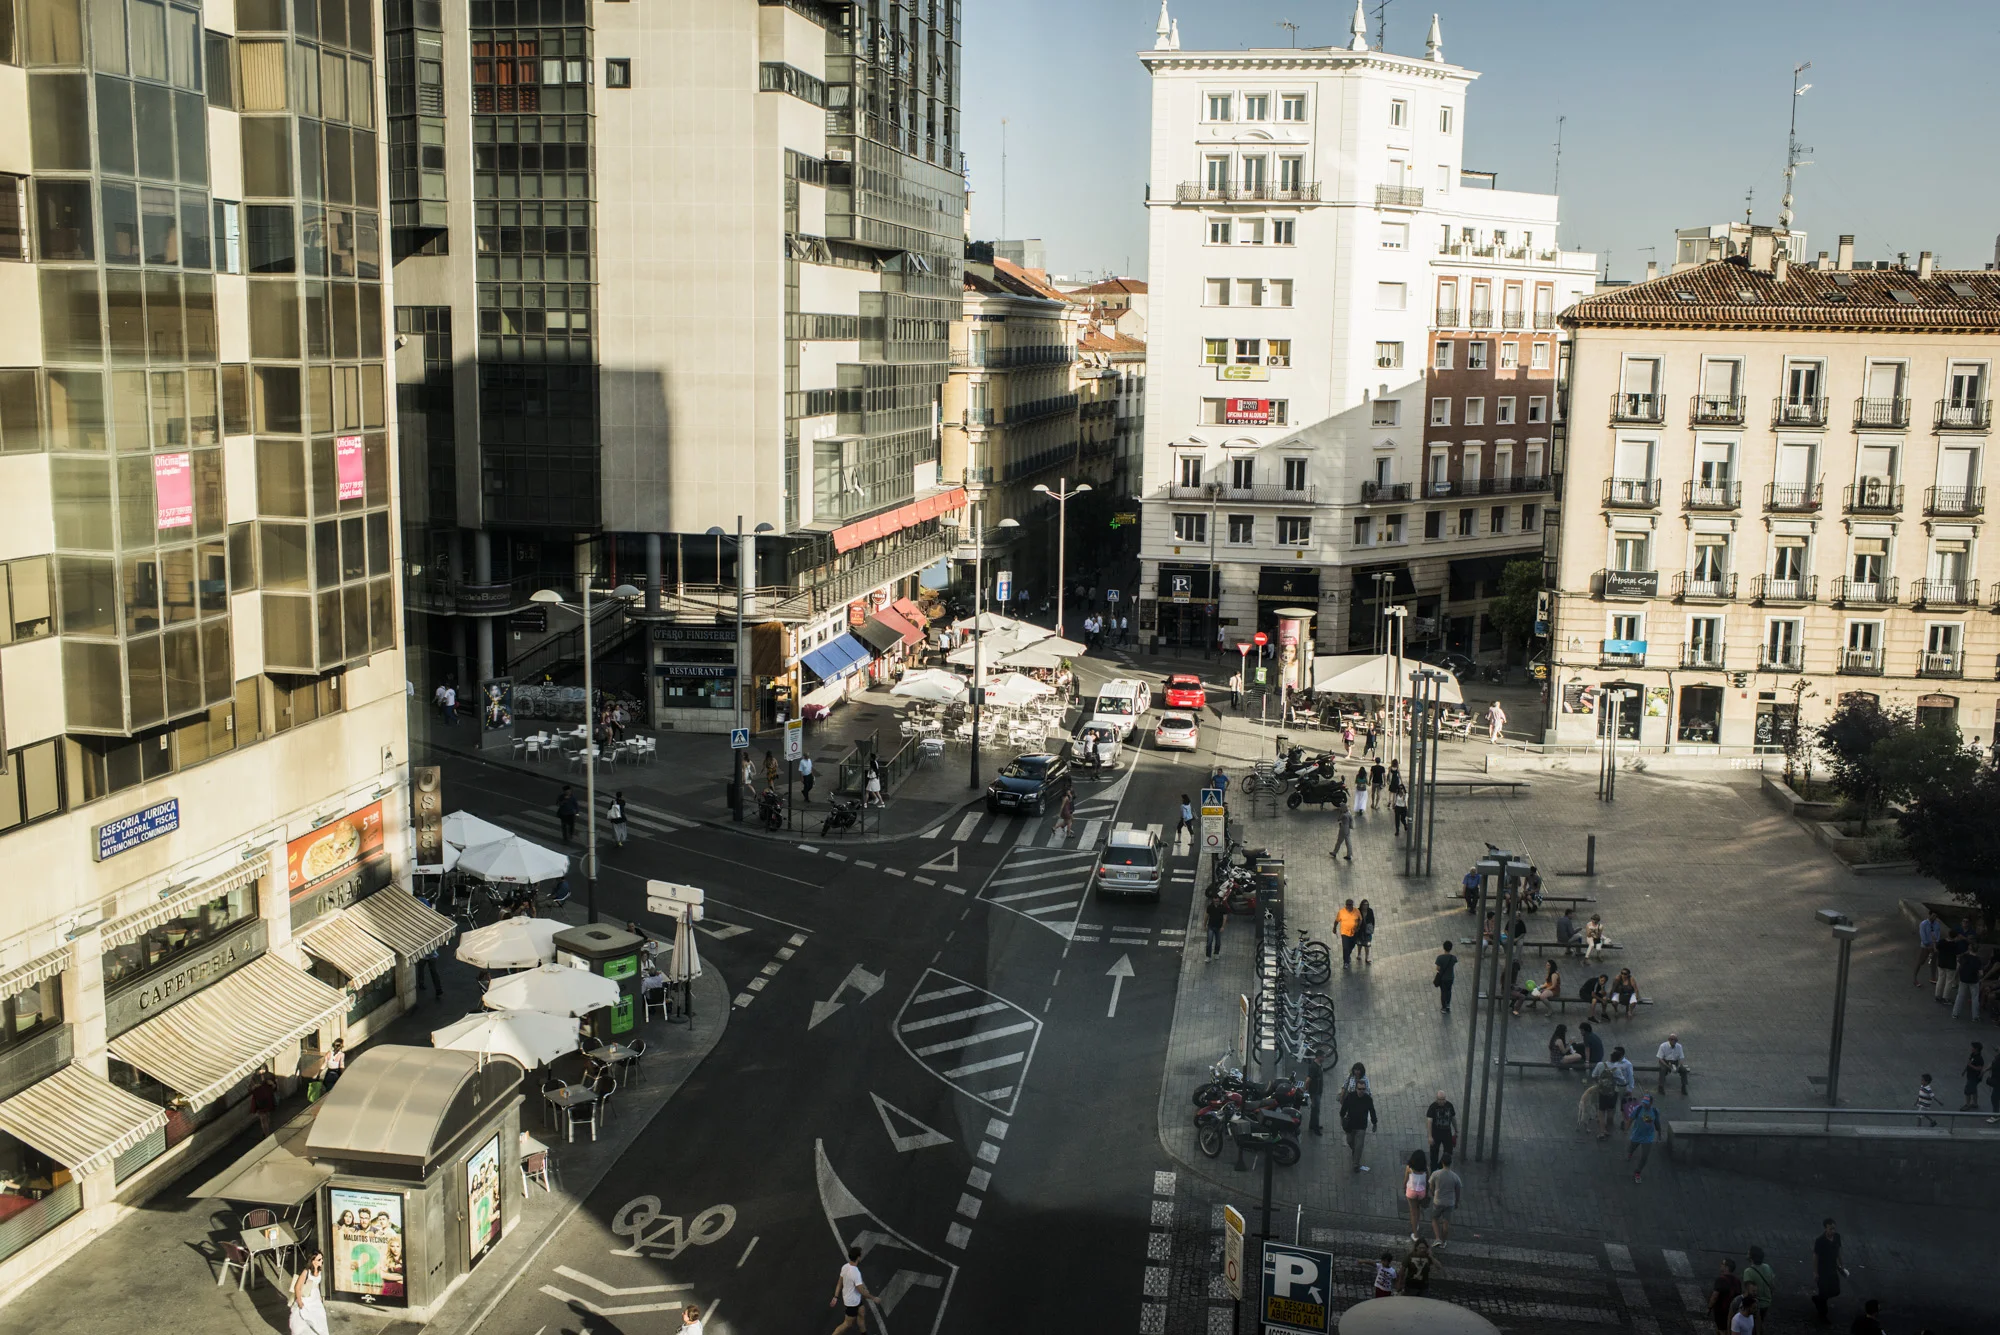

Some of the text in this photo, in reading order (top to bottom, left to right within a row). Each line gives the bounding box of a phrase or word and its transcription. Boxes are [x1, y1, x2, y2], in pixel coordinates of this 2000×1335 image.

[1249, 411, 1268, 419] ALQUILER
[156, 455, 179, 468] Oficina
[1175, 578, 1187, 591] P
[686, 630, 736, 640] FINISTERRE
[669, 667, 725, 676] RESTAURANTE
[101, 800, 177, 839] ASESORIA JURIDICA
[101, 811, 177, 848] CIVIL LABORAL FISCAL
[101, 820, 178, 858] MATRIMONIAL COMUNIDADES
[139, 945, 237, 1010] CAFETERIA
[343, 1233, 389, 1245] MALDITOS VECINOS
[351, 1243, 383, 1284] 2
[1274, 1253, 1319, 1298] P
[1270, 1298, 1323, 1317] Pza. DESCALZAS
[1271, 1308, 1301, 1324] ABIERTO
[1303, 1314, 1311, 1325] 24
